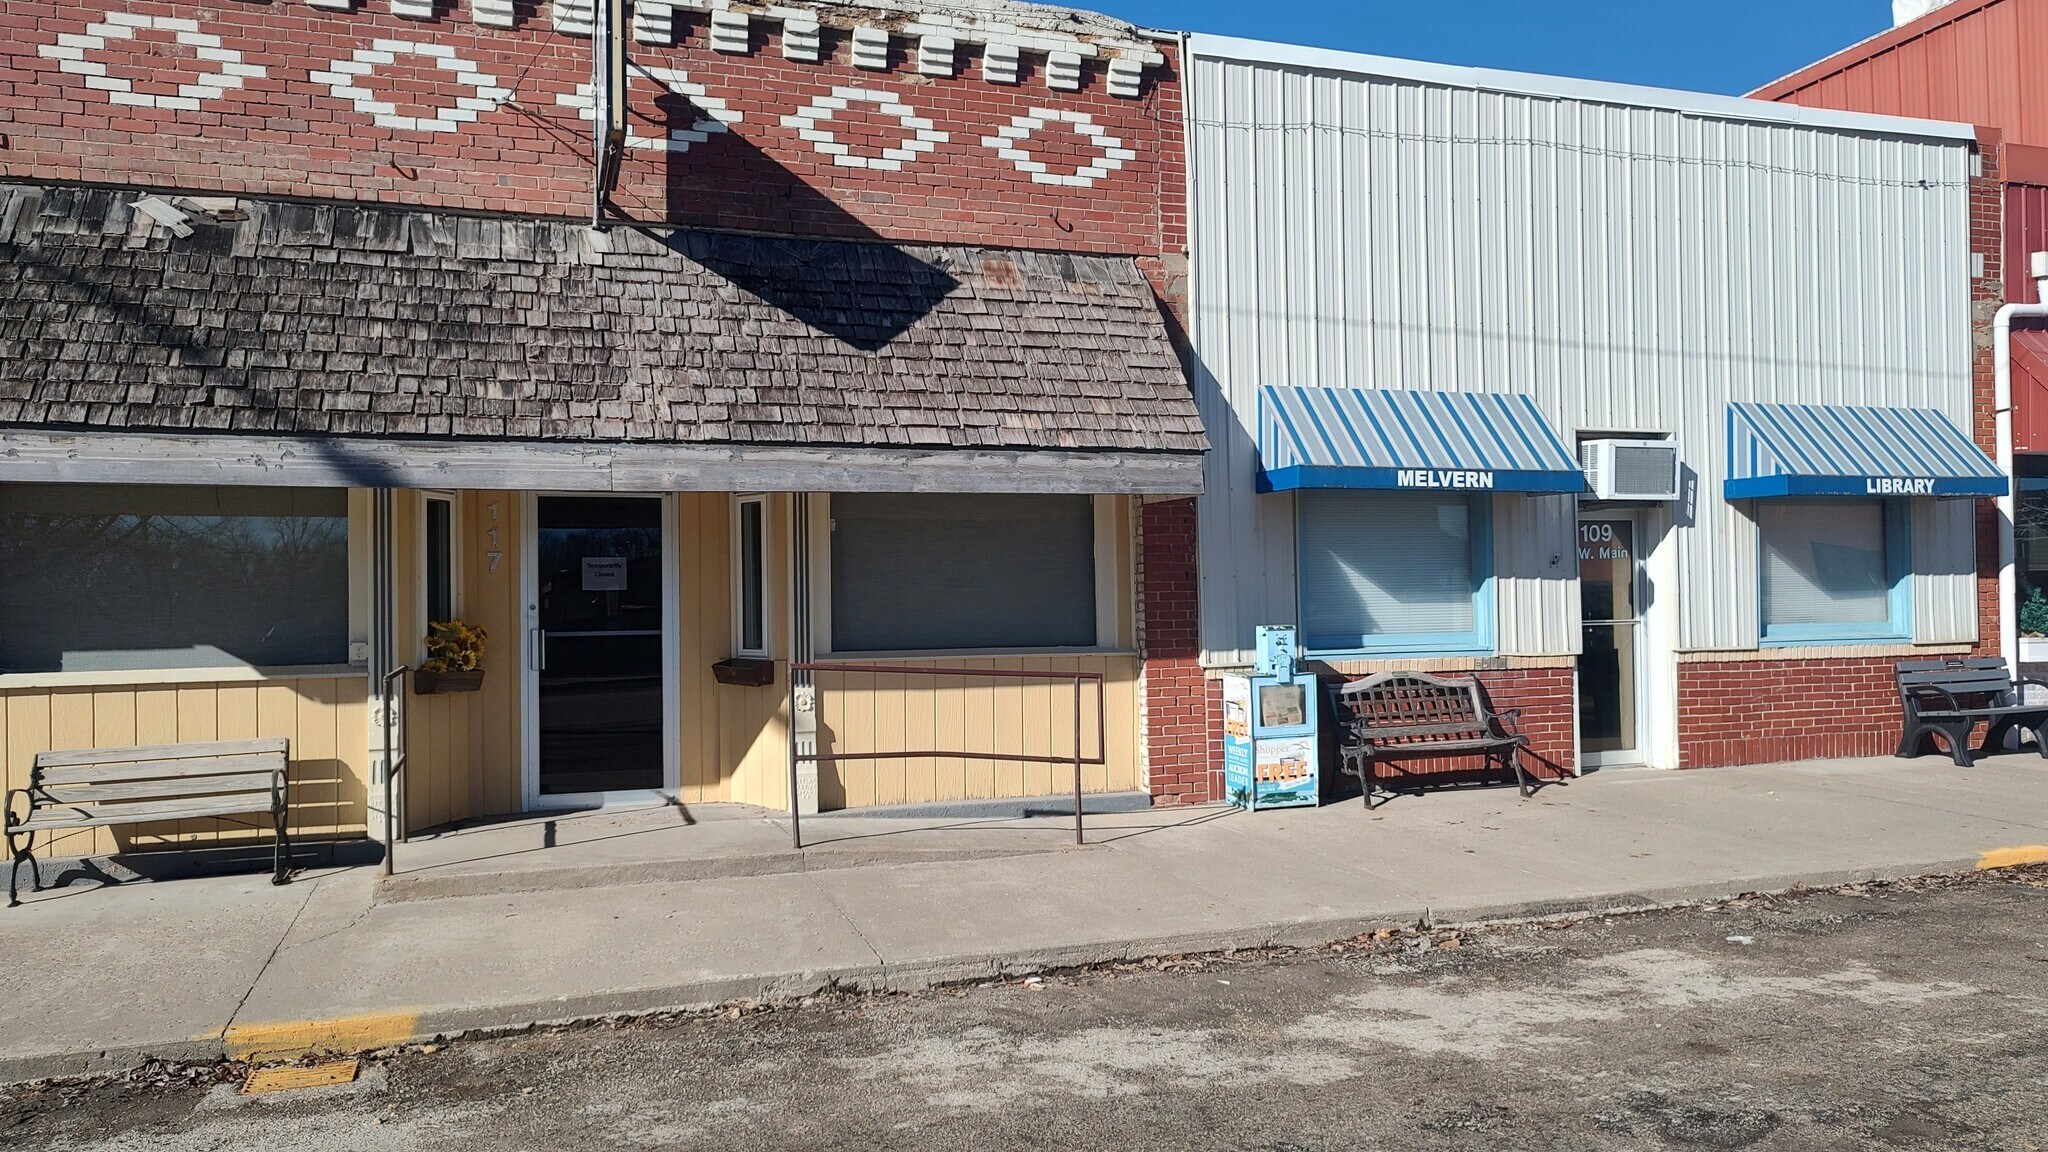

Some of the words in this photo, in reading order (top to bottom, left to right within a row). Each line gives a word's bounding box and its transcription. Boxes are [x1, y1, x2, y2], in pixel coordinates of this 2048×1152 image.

[1397, 470, 1493, 488] MELVERN
[1866, 478, 1936, 494] LIBRARY
[486, 500, 503, 573] 117
[1580, 524, 1612, 542] 109
[1578, 547, 1594, 560] W.
[1599, 546, 1628, 560] Main
[1226, 719, 1249, 738] FREE
[1227, 744, 1248, 758] WEEKLY
[1228, 772, 1249, 786] LEADER
[1257, 761, 1308, 785] FREE
